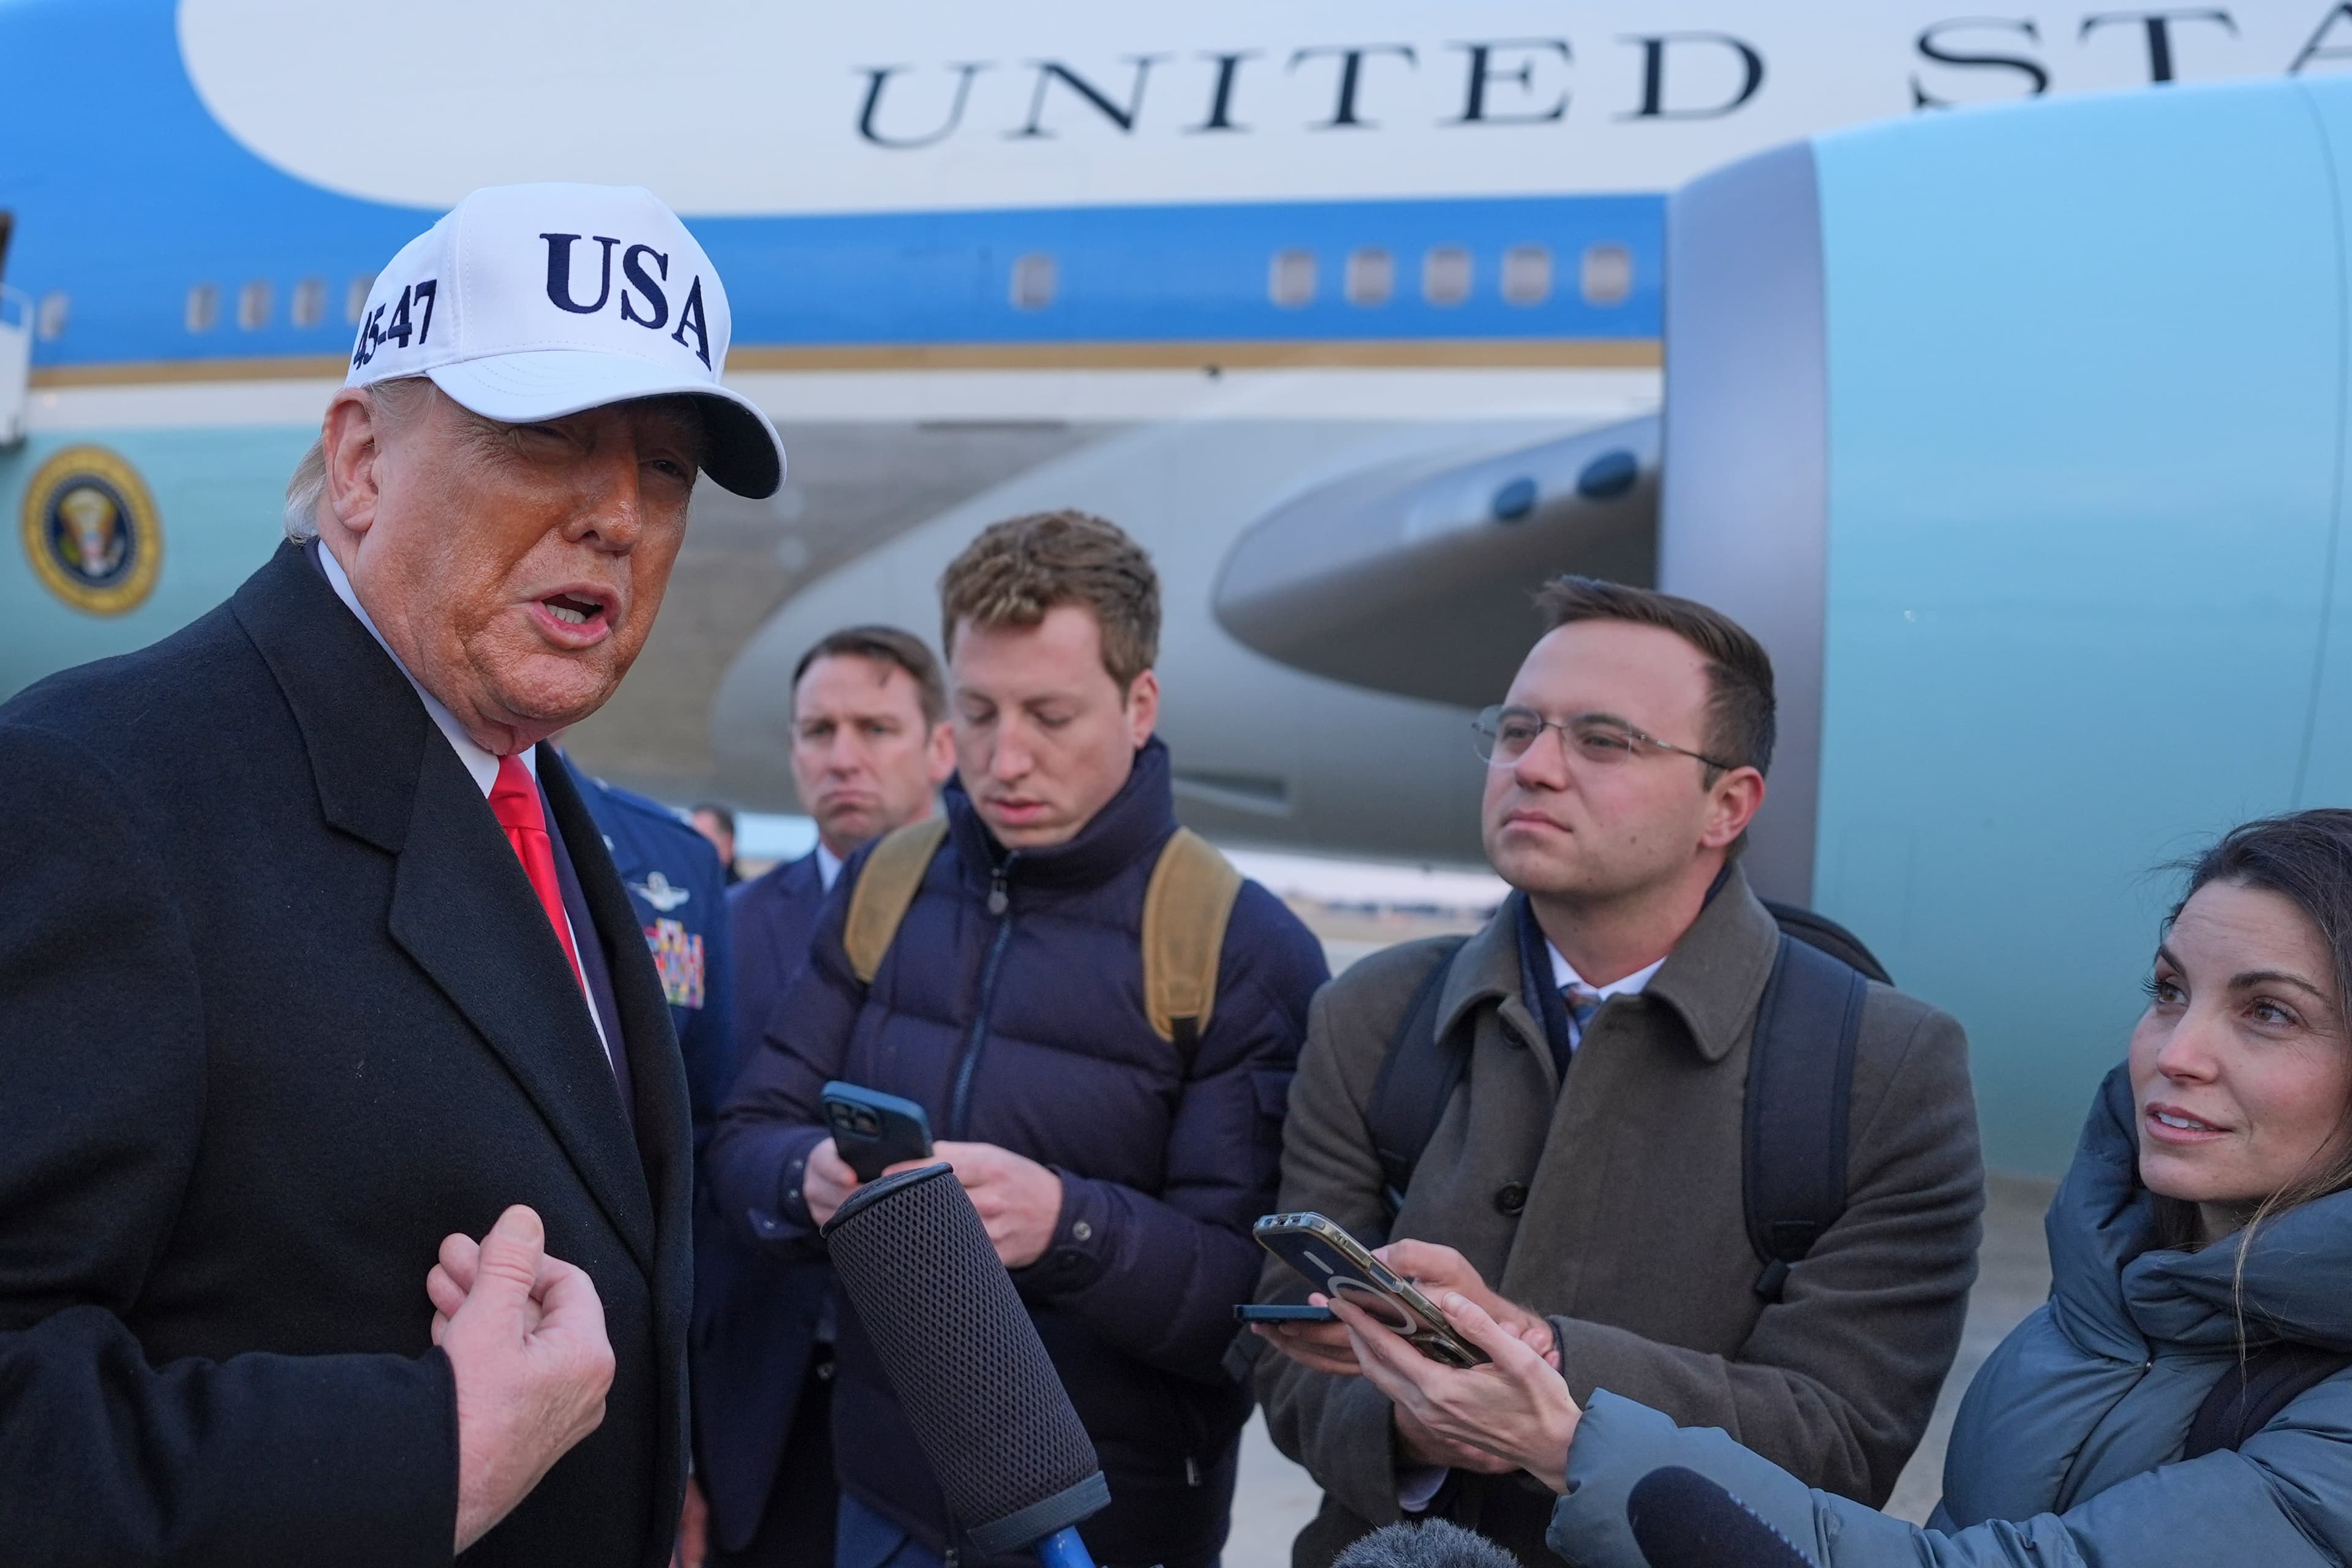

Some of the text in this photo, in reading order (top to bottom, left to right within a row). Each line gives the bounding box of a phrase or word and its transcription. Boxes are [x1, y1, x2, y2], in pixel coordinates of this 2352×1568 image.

[849, 31, 1768, 150] UNITED
[353, 279, 437, 370] 45-47
[539, 233, 711, 372] USA
